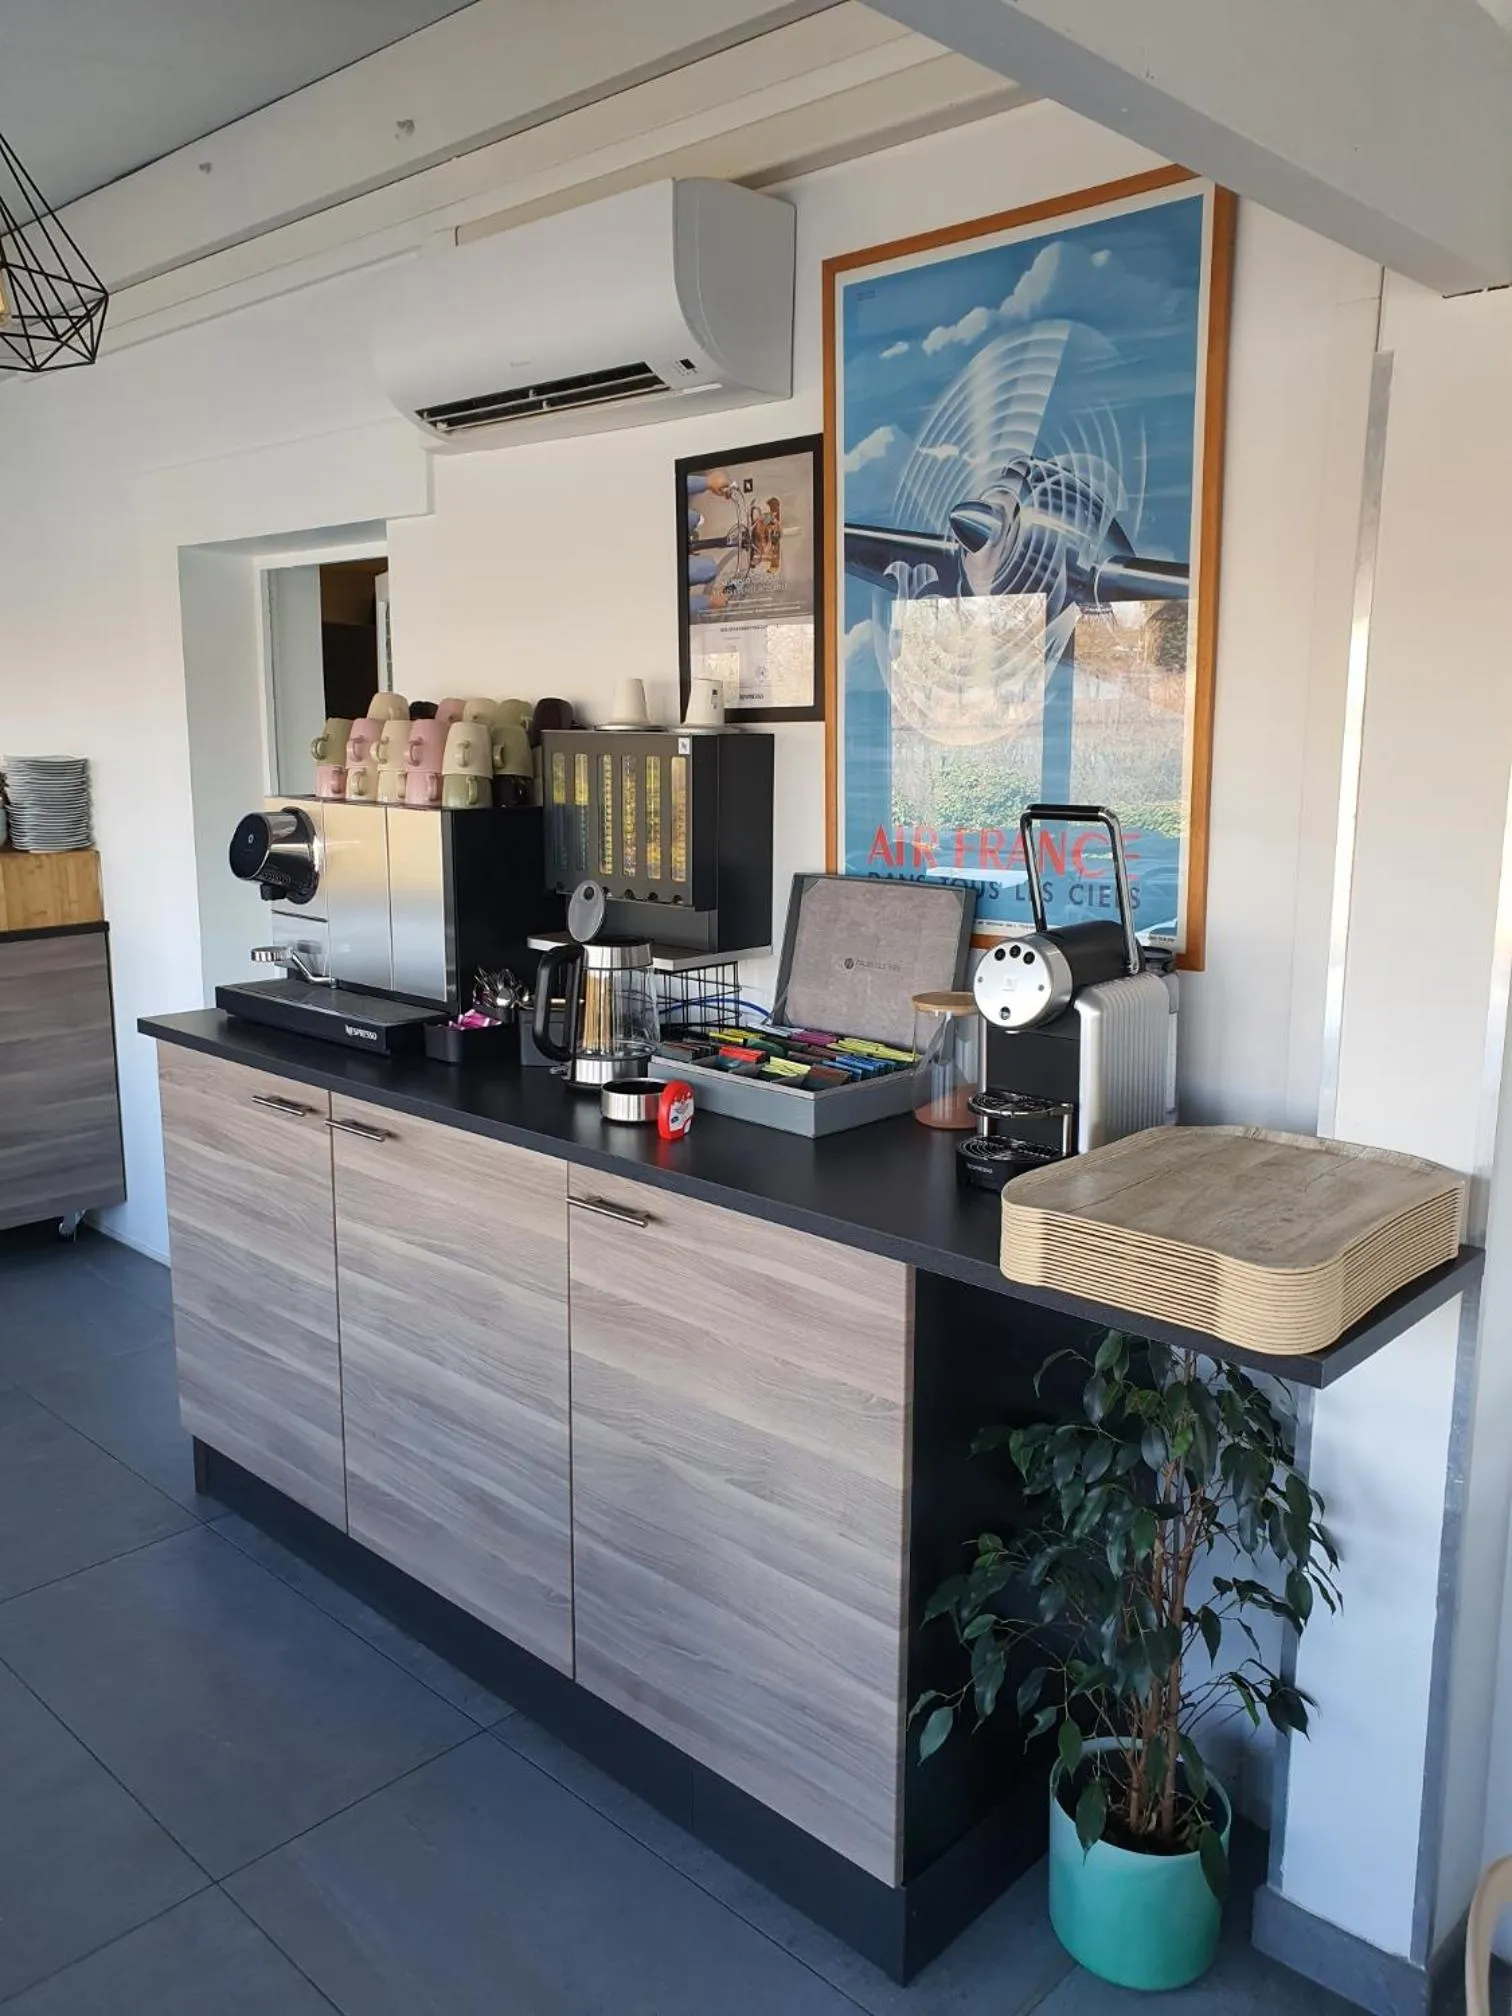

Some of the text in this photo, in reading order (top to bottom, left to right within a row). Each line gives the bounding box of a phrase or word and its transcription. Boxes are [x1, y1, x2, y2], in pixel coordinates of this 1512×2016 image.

[867, 823, 1141, 880] AIR FRANCE
[1016, 881, 1054, 903] LS
[1069, 883, 1141, 910] CIES
